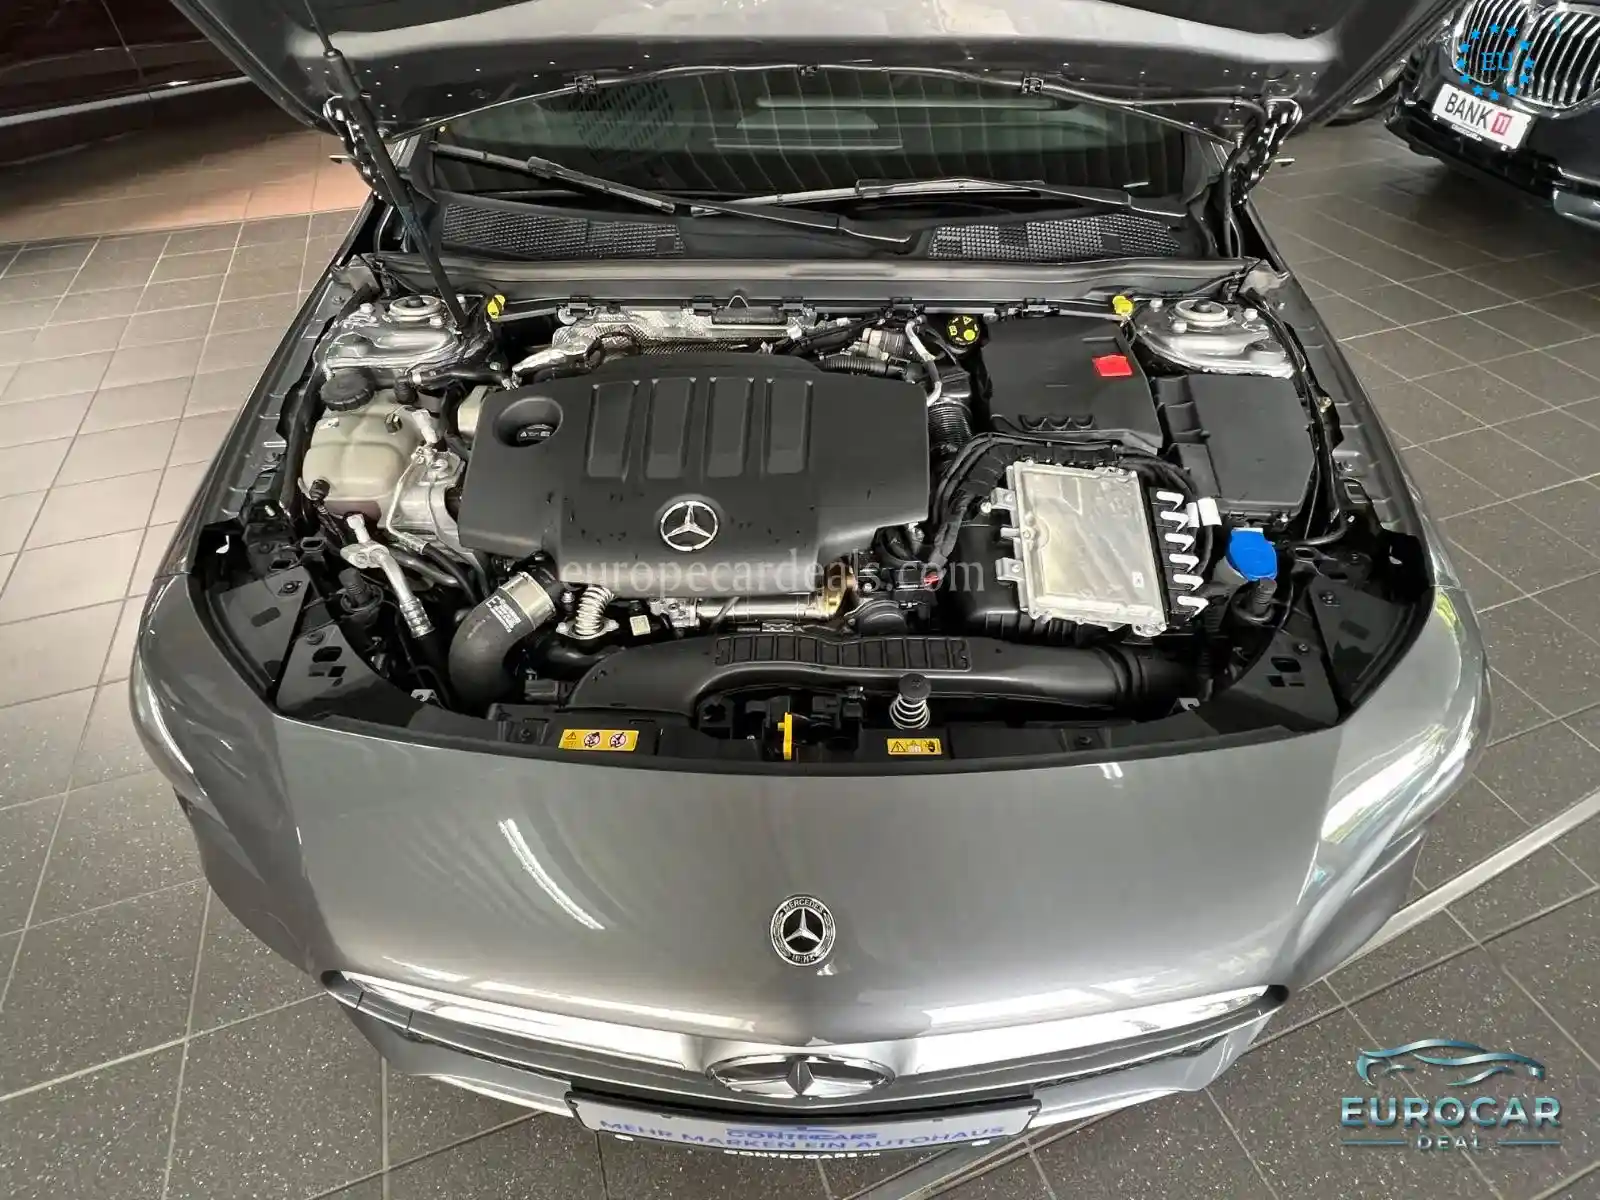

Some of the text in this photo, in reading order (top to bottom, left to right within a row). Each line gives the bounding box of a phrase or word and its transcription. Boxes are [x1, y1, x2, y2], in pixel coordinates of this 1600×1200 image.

[1444, 92, 1495, 130] BANK
[783, 898, 824, 914] MERCEDES
[600, 1120, 1005, 1149] MEHR MARKEN EIN AUTOHAUS
